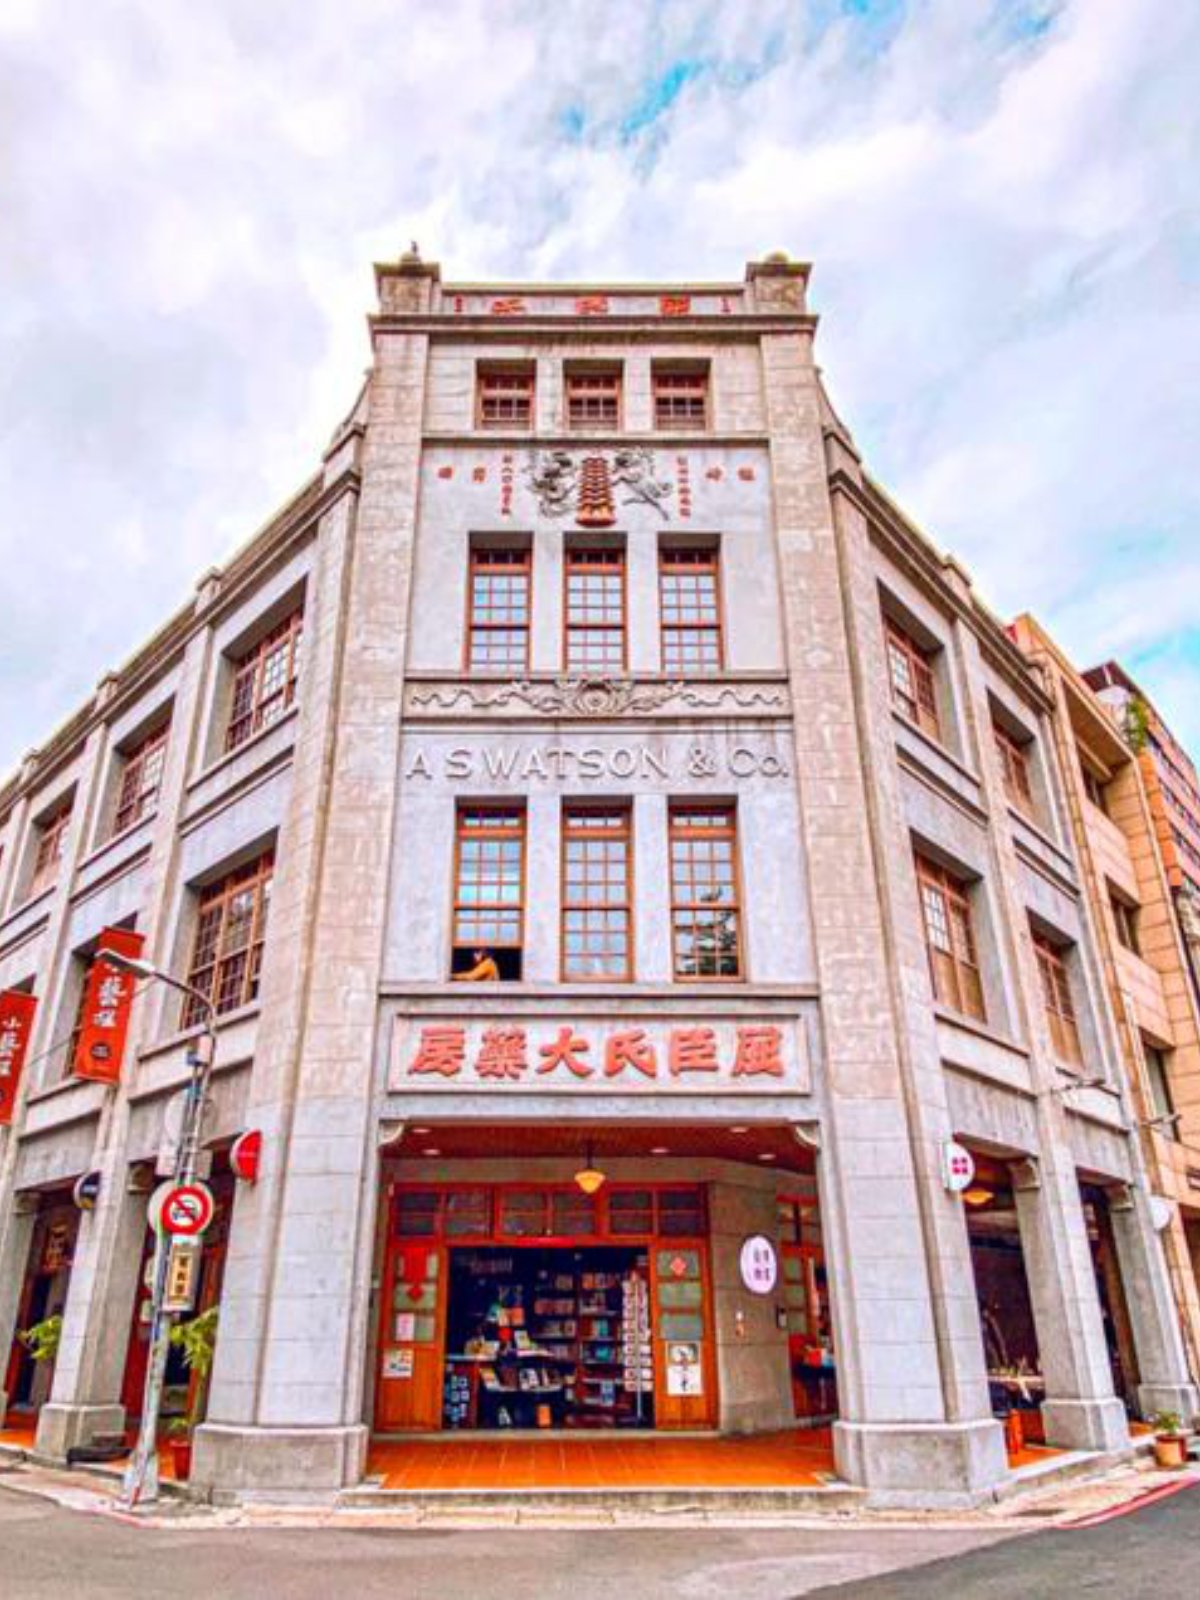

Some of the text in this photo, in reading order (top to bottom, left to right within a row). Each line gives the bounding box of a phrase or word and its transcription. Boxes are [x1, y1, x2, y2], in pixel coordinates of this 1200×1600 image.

[404, 747, 432, 780] A
[687, 747, 717, 779] &
[728, 748, 790, 779] Co.
